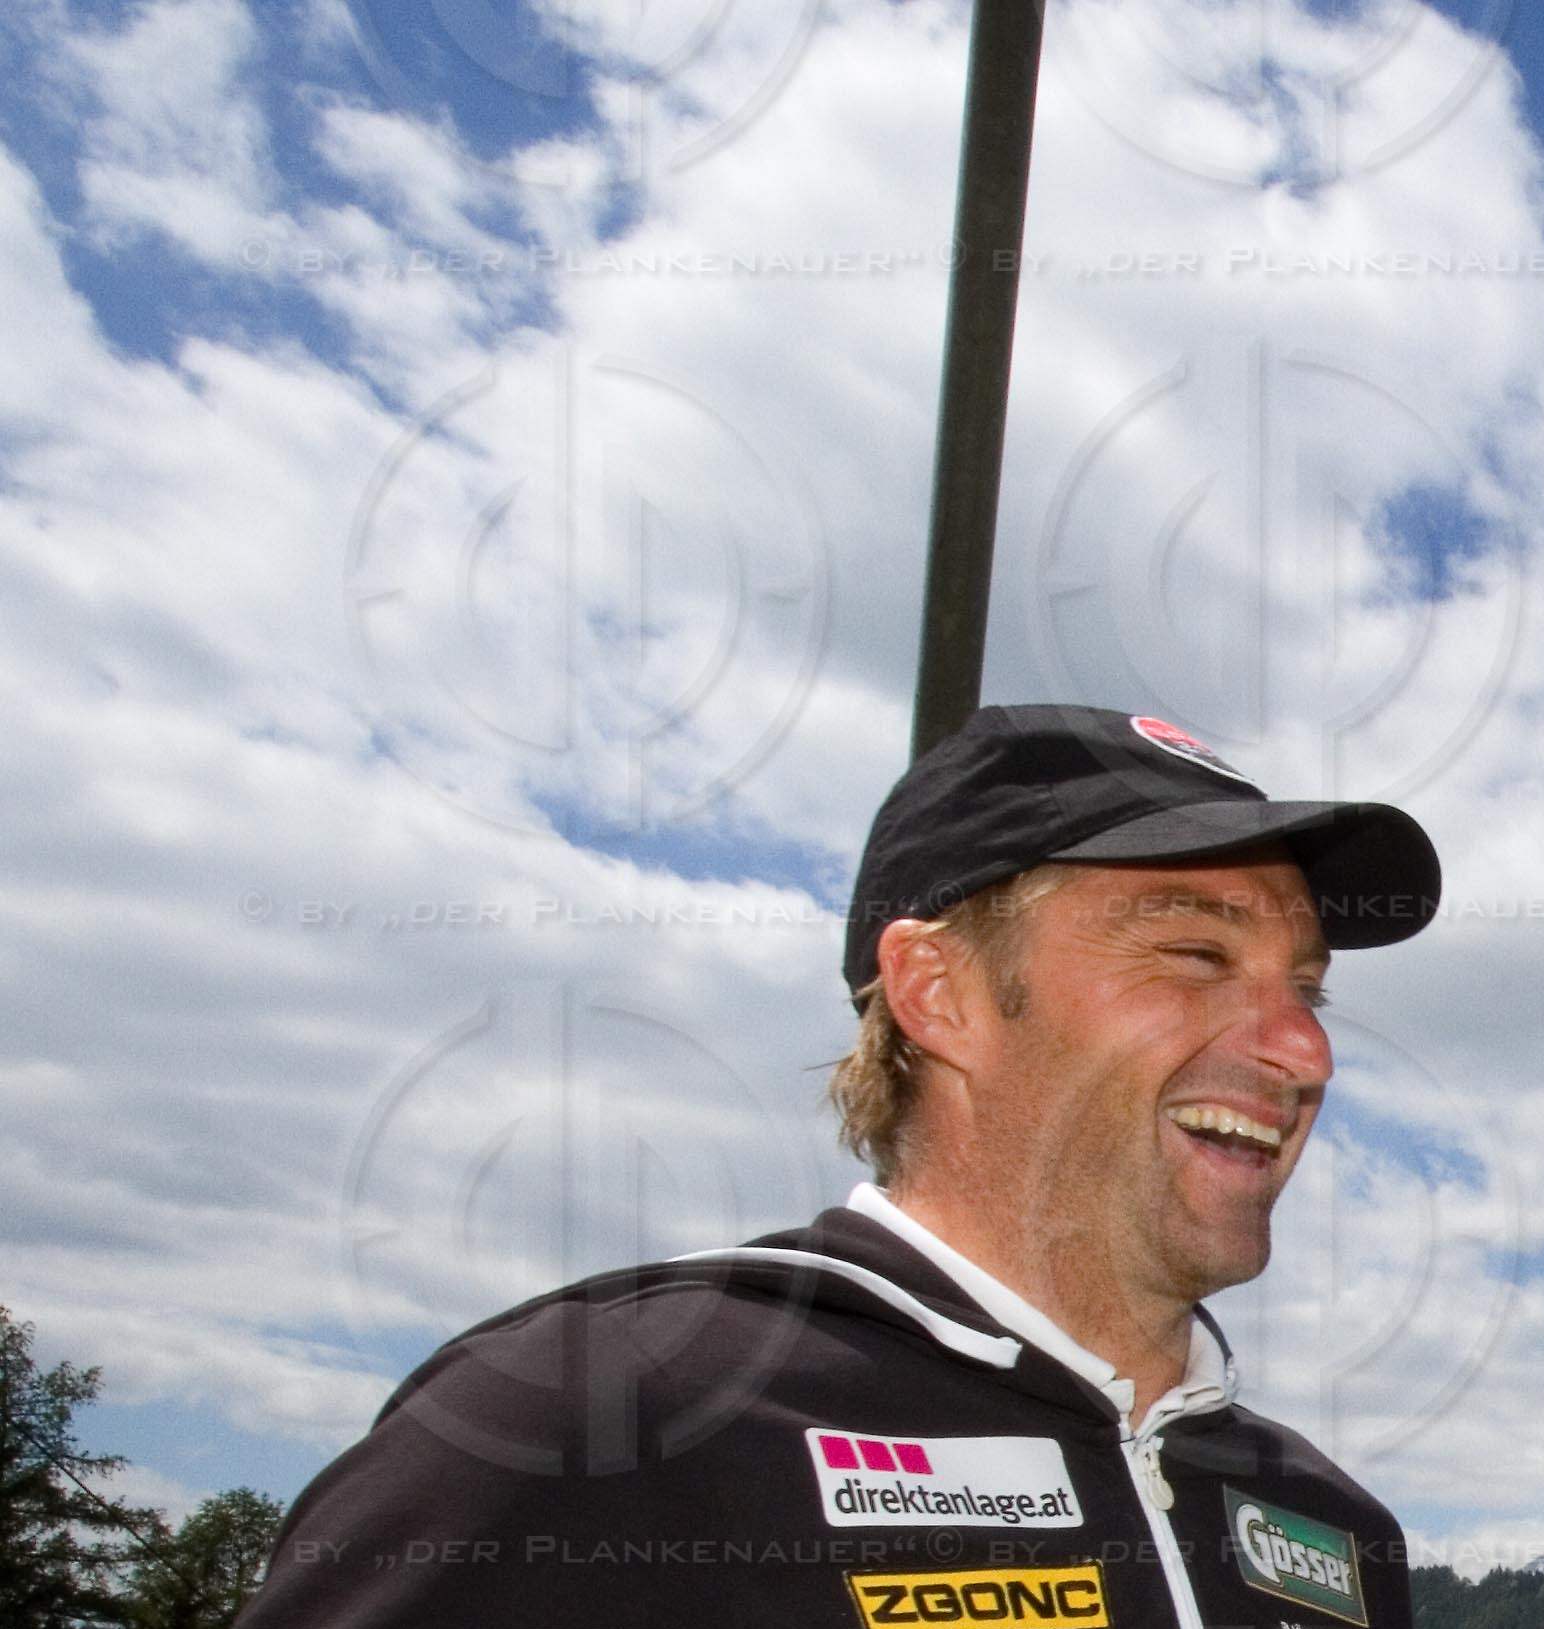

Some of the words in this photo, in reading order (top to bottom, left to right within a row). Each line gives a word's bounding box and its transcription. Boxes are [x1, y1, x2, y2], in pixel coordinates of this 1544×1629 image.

[834, 1478, 1074, 1523] direktanlage.at
[1236, 1503, 1351, 1595] Gösser
[859, 1579, 1101, 1625] ZGONC
